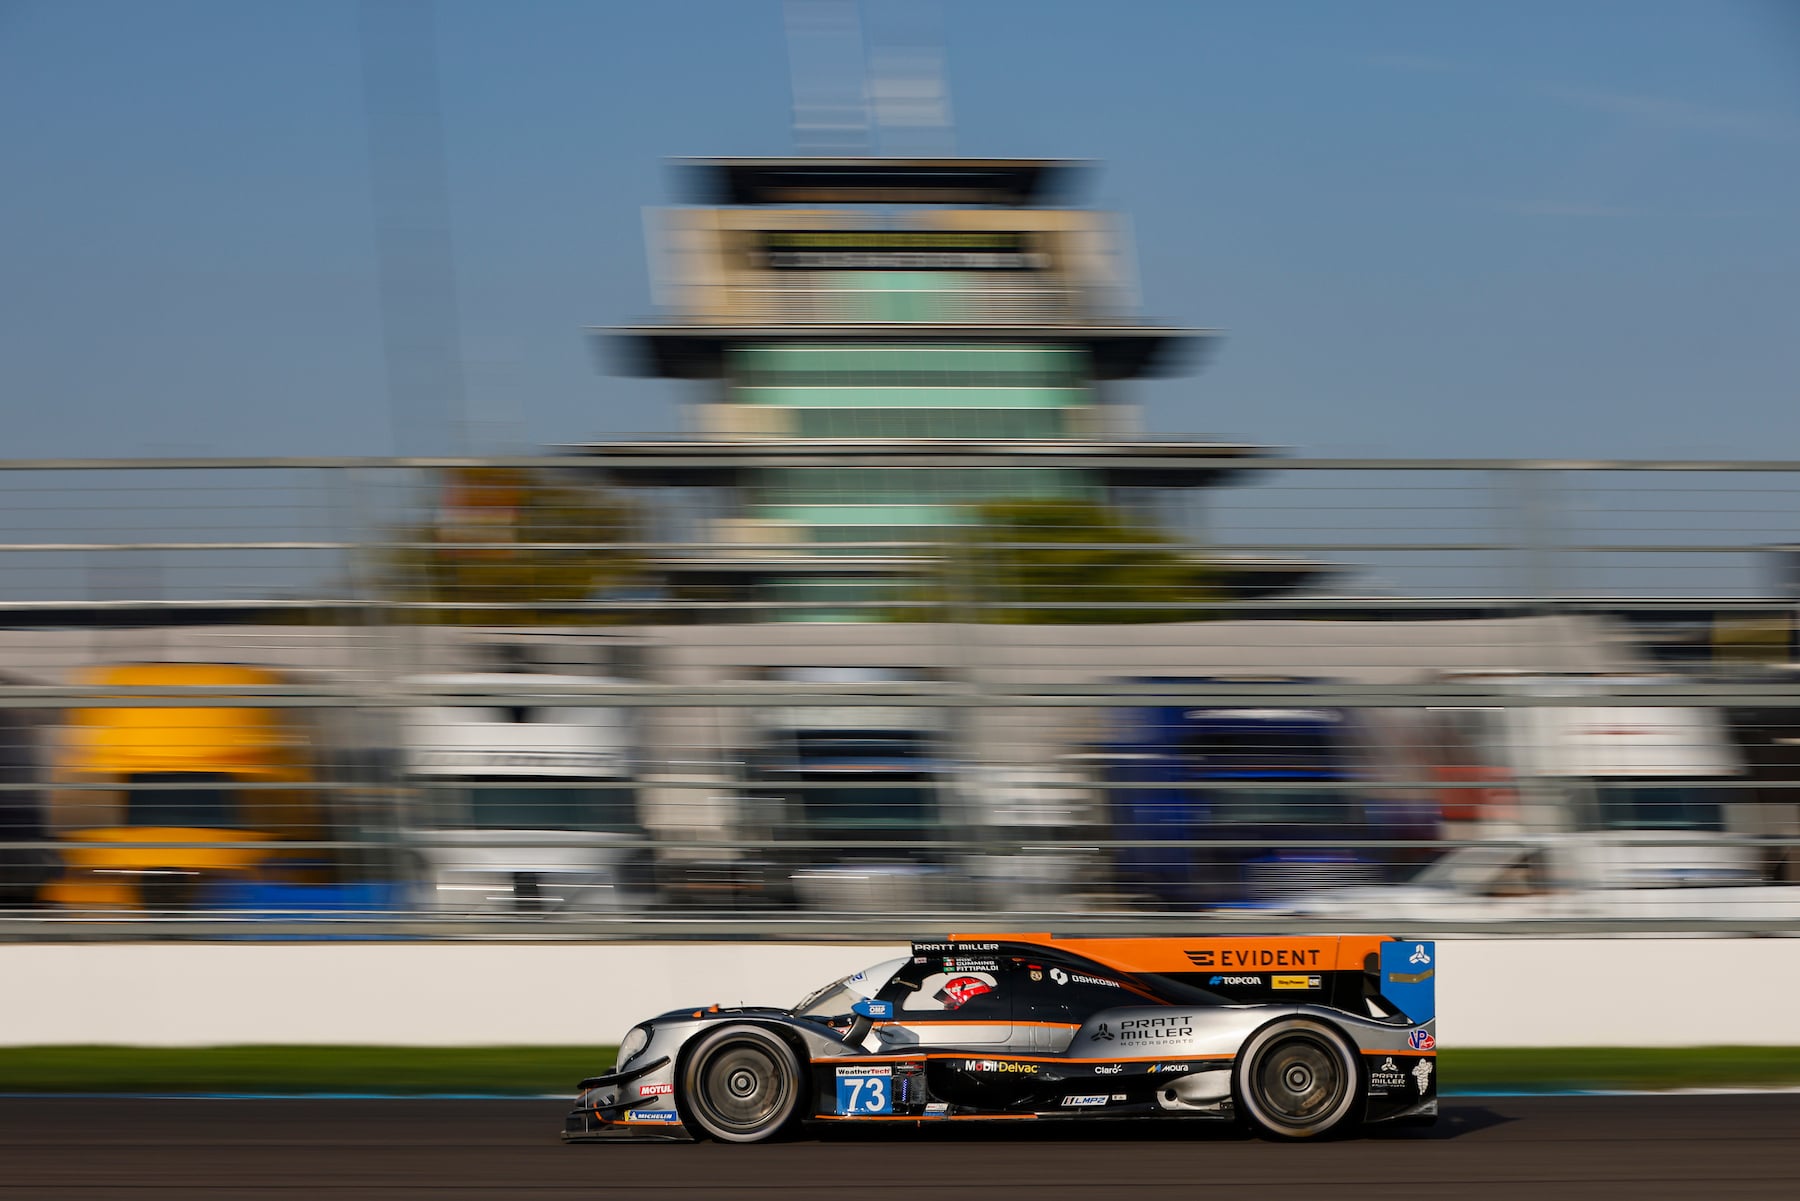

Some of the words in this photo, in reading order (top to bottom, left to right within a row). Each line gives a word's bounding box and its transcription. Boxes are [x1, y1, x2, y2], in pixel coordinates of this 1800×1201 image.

[1221, 950, 1320, 966] EVIDENT
[1071, 974, 1121, 988] OSHKOSH
[1222, 976, 1262, 985] TOPCON
[1121, 1016, 1193, 1030] PRATT
[1121, 1027, 1193, 1040] MILLER
[1410, 1029, 1428, 1049] VP
[1120, 1038, 1194, 1046] MOTORSPORTS
[965, 1060, 997, 1072] Mobil
[998, 1062, 1038, 1073] Delvac
[1094, 1065, 1120, 1074] Claro
[641, 1085, 672, 1094] MOTUL
[844, 1077, 886, 1112] 73
